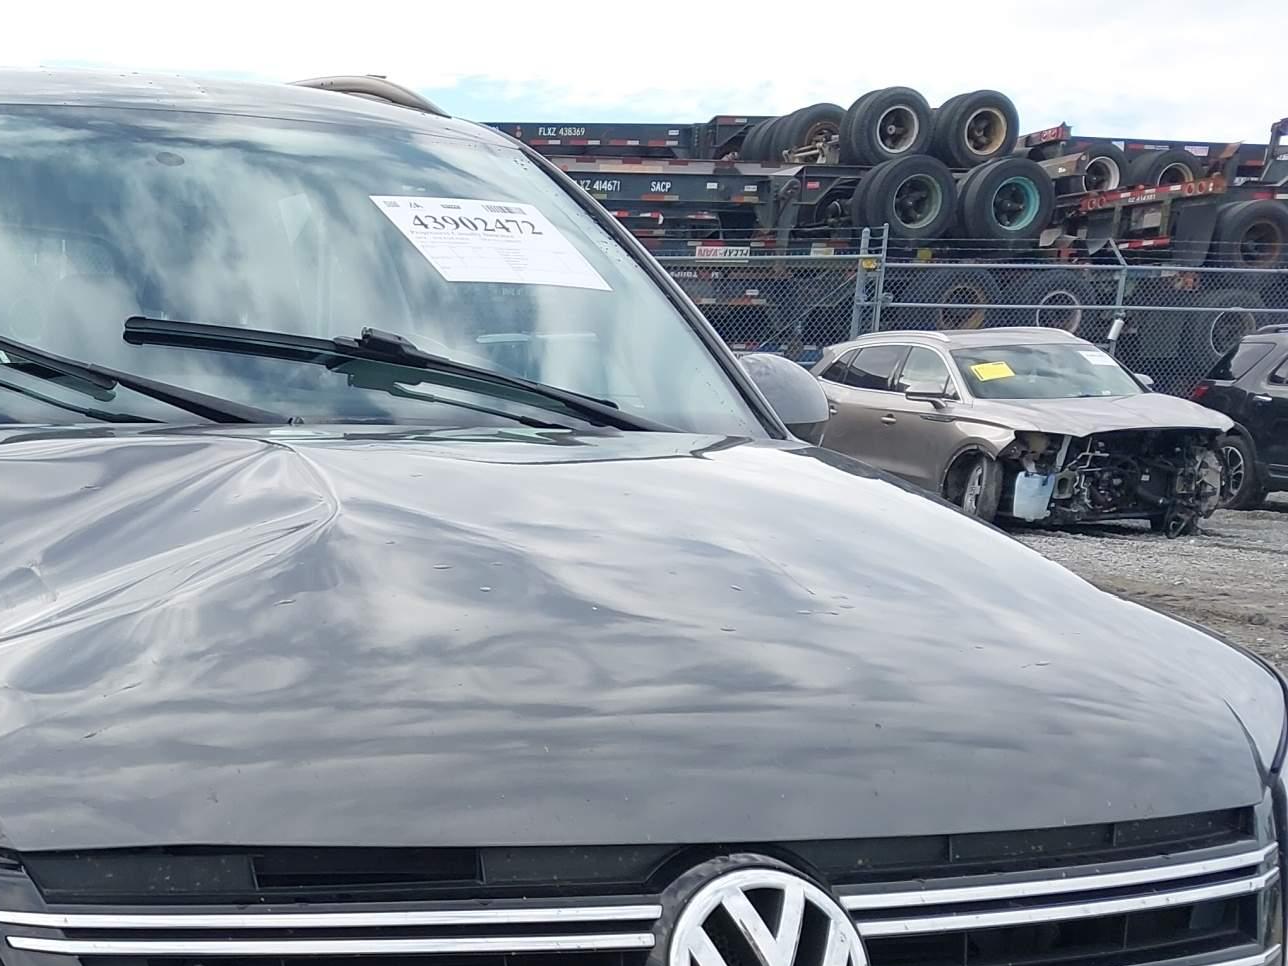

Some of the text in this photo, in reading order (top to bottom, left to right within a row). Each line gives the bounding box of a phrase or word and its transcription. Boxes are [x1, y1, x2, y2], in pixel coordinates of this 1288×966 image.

[538, 127, 585, 136] FLXZ 438369
[593, 180, 621, 191] 414671
[651, 181, 672, 192] SACP
[412, 214, 543, 235] 43902472
